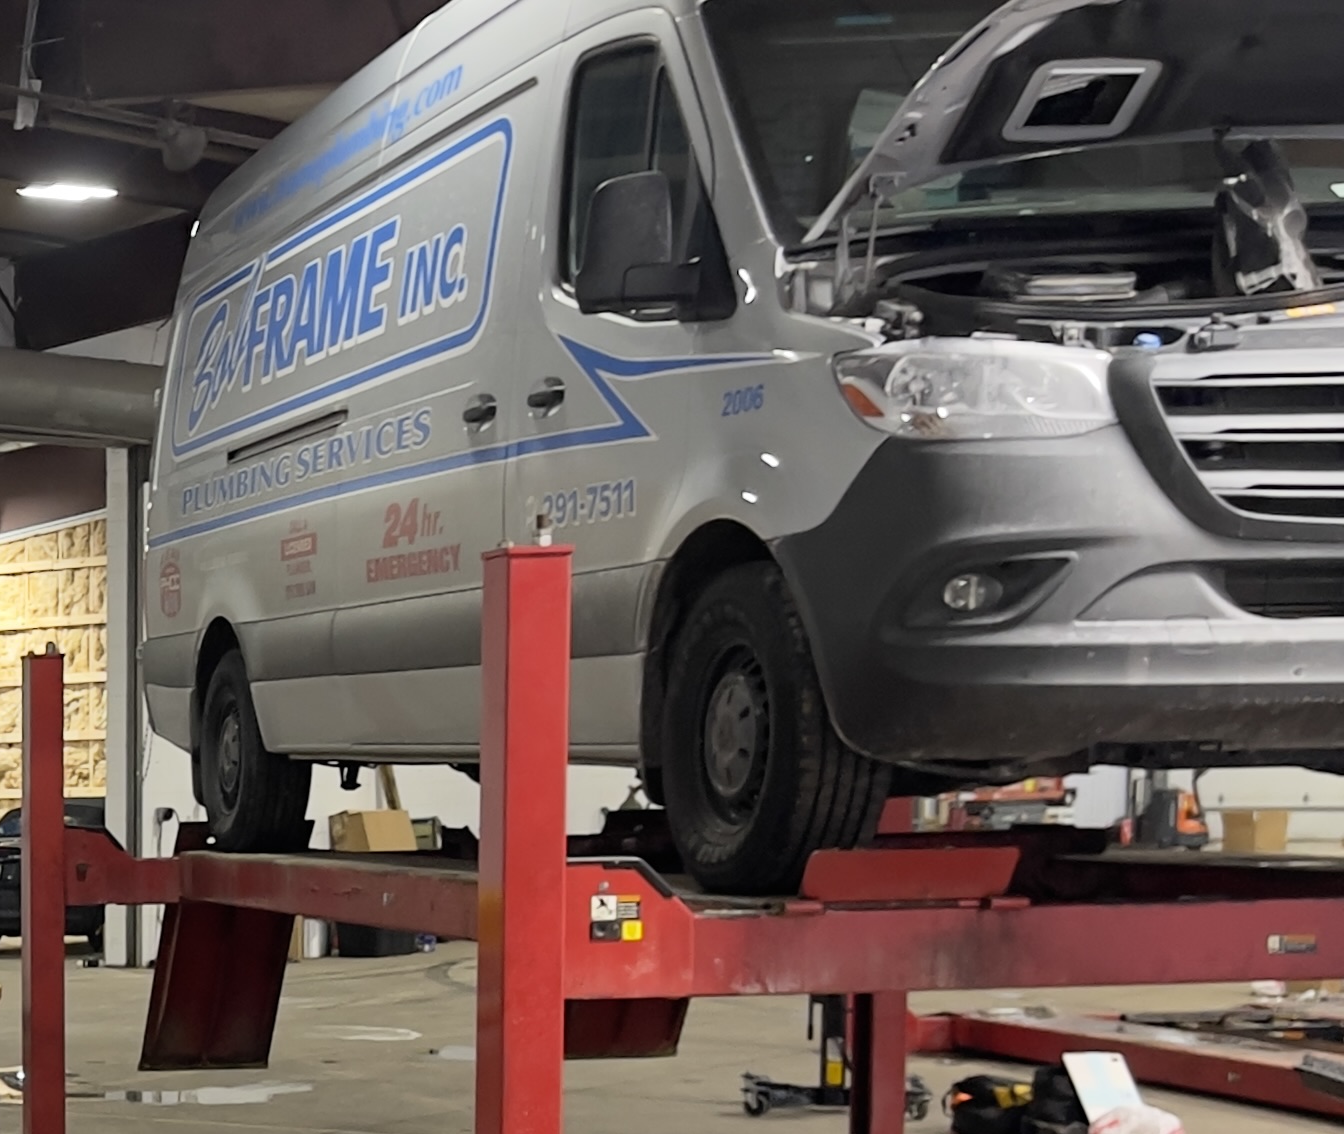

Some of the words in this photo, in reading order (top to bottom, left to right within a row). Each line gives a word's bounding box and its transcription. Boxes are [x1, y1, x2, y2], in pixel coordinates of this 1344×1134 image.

[242, 214, 401, 392] FRAME
[398, 223, 468, 326] INC.
[721, 384, 765, 417] 2006
[182, 455, 291, 517] PLUMBING
[296, 406, 433, 481] SERVICES
[382, 498, 420, 548] 24
[420, 503, 444, 537] hr.
[366, 544, 461, 584] EMERGENCY
